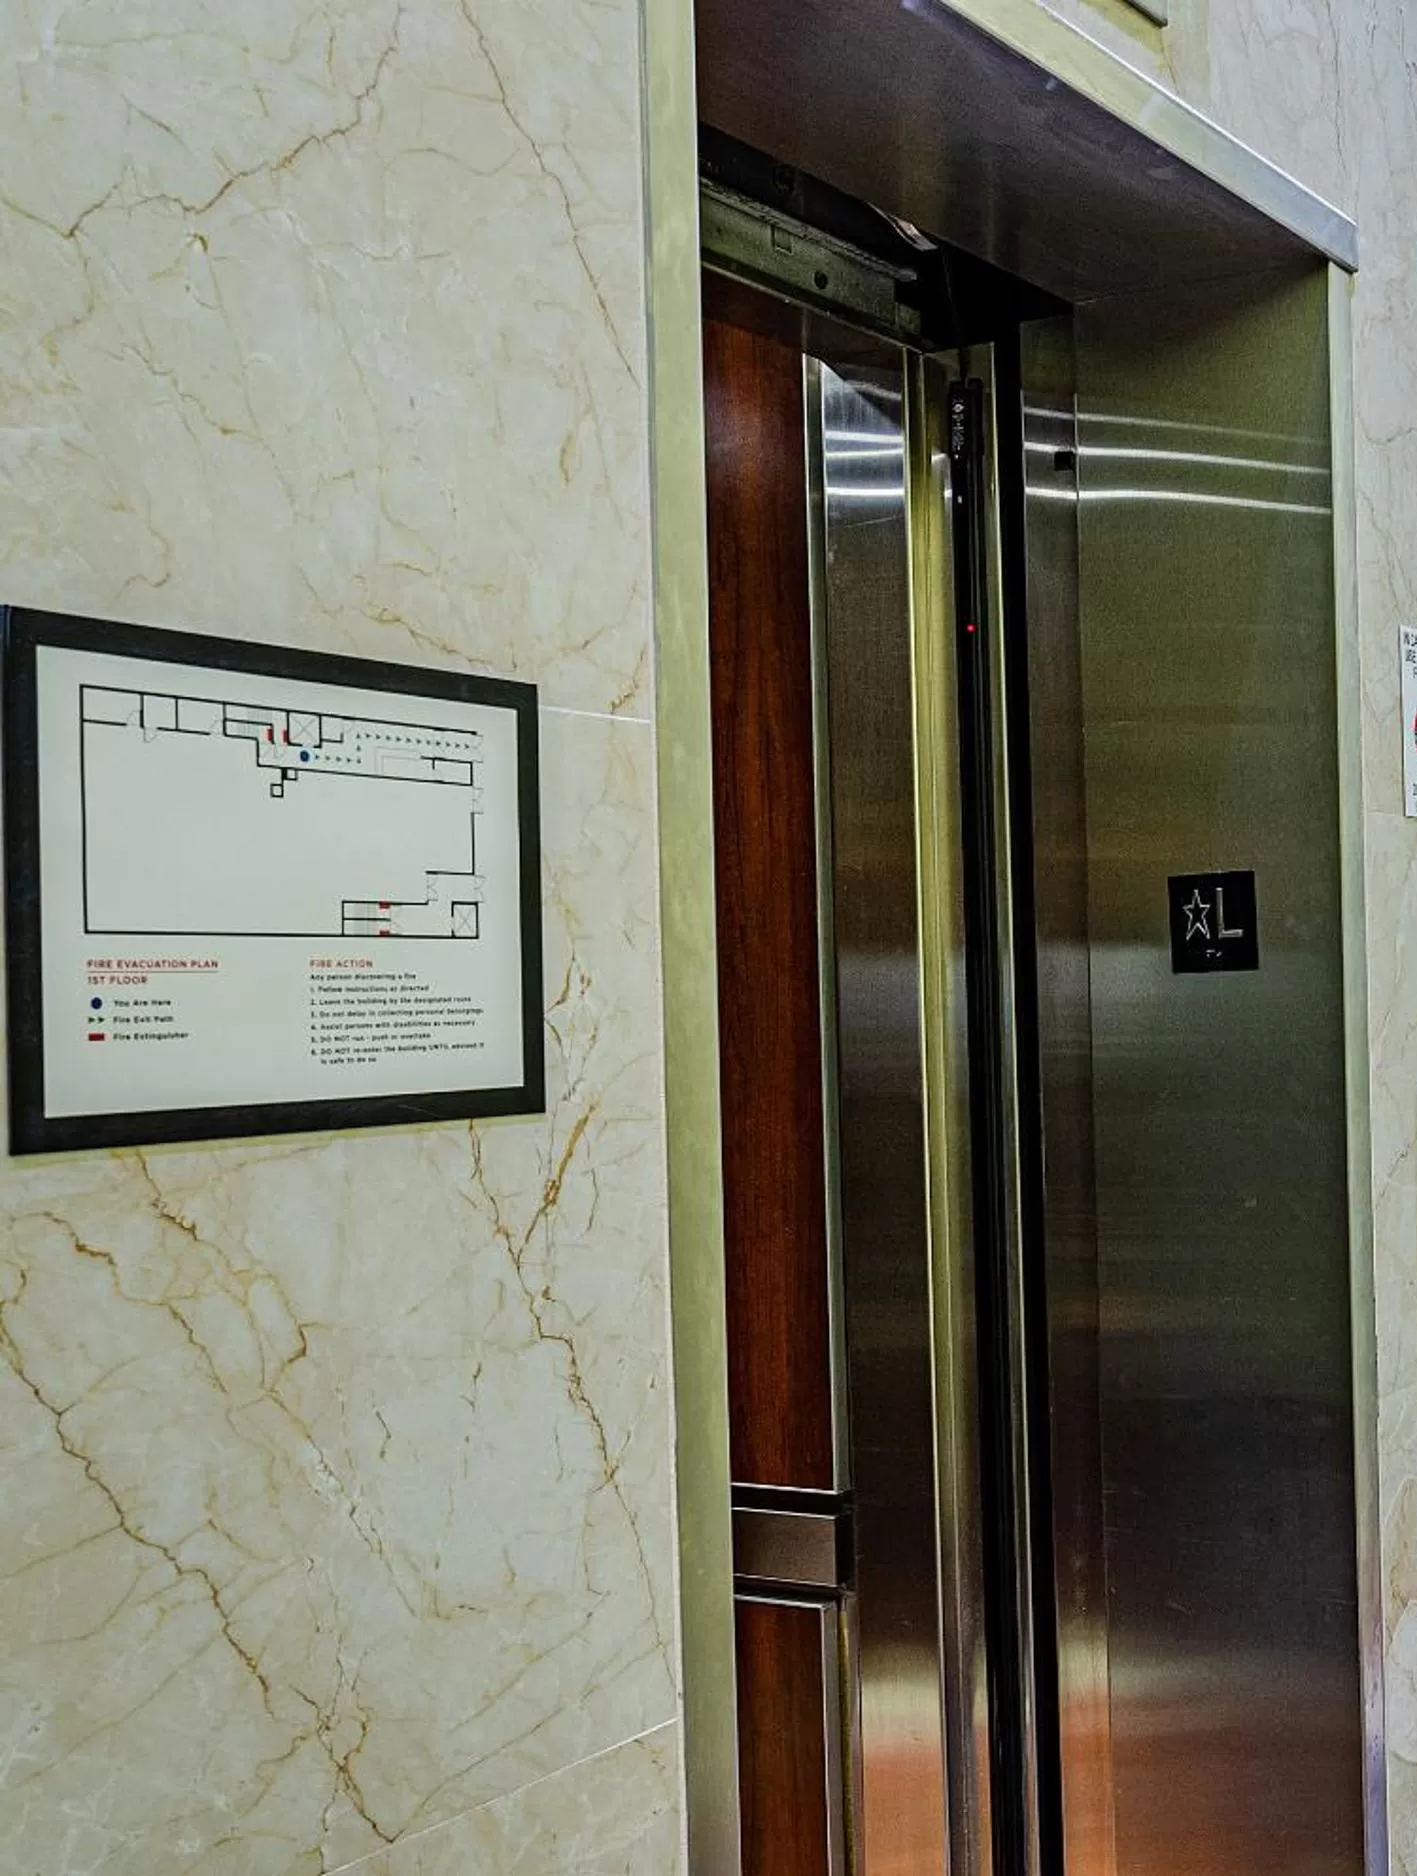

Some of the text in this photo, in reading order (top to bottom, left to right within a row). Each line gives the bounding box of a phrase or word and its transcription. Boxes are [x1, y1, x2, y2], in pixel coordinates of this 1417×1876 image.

[1215, 887, 1244, 939] L
[87, 959, 218, 969] FIRE EVACUATION PLAN
[309, 959, 373, 969] FIRE ACTION
[87, 975, 148, 985] 1ST FLOOR
[113, 999, 130, 1007] You
[133, 1015, 151, 1023] Exit
[152, 1015, 174, 1023] Path
[112, 1032, 189, 1041] Fire Extinguisher
